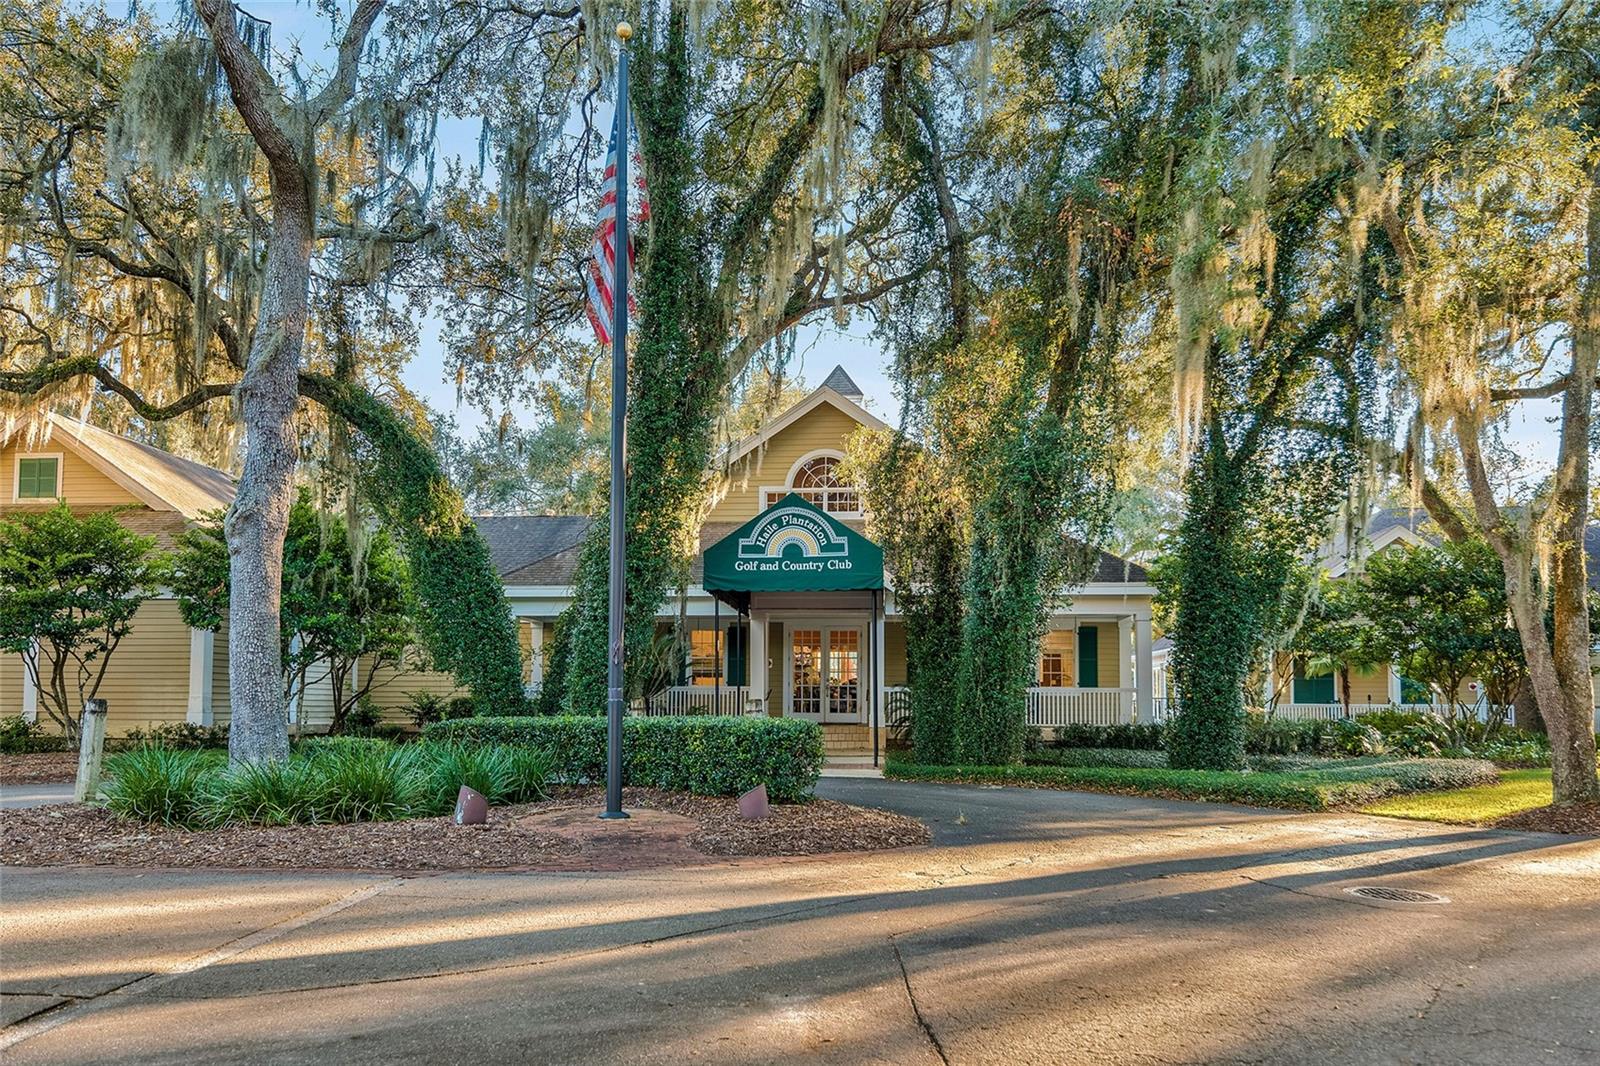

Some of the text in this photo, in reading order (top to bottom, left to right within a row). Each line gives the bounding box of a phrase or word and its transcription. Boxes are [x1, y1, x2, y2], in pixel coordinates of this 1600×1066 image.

[756, 515, 828, 548] Haile Plantation
[735, 560, 852, 572] Golf and Country Club
